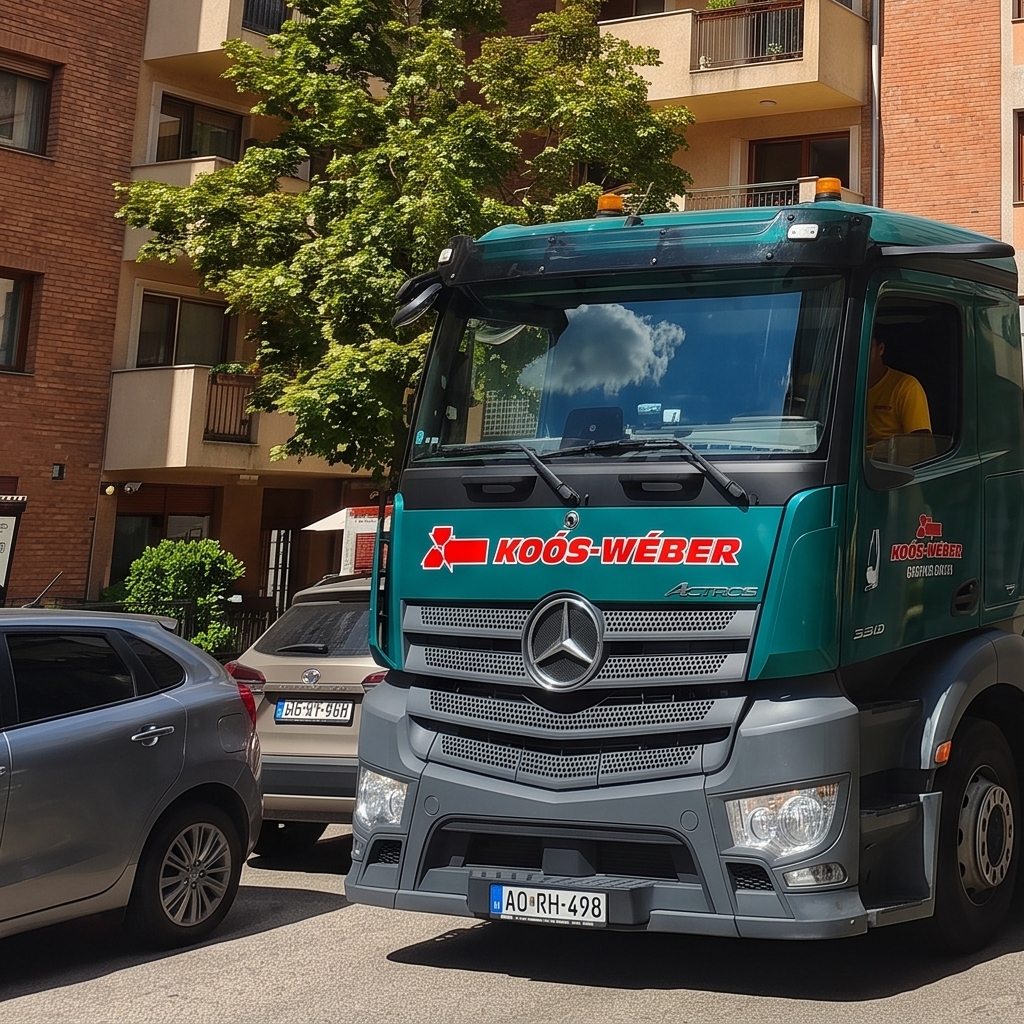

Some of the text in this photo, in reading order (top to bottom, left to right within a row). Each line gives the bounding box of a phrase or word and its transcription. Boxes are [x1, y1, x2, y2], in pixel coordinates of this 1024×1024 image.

[493, 530, 743, 565] KOÓS-WÉBER
[505, 890, 602, 918] AO RH-498
